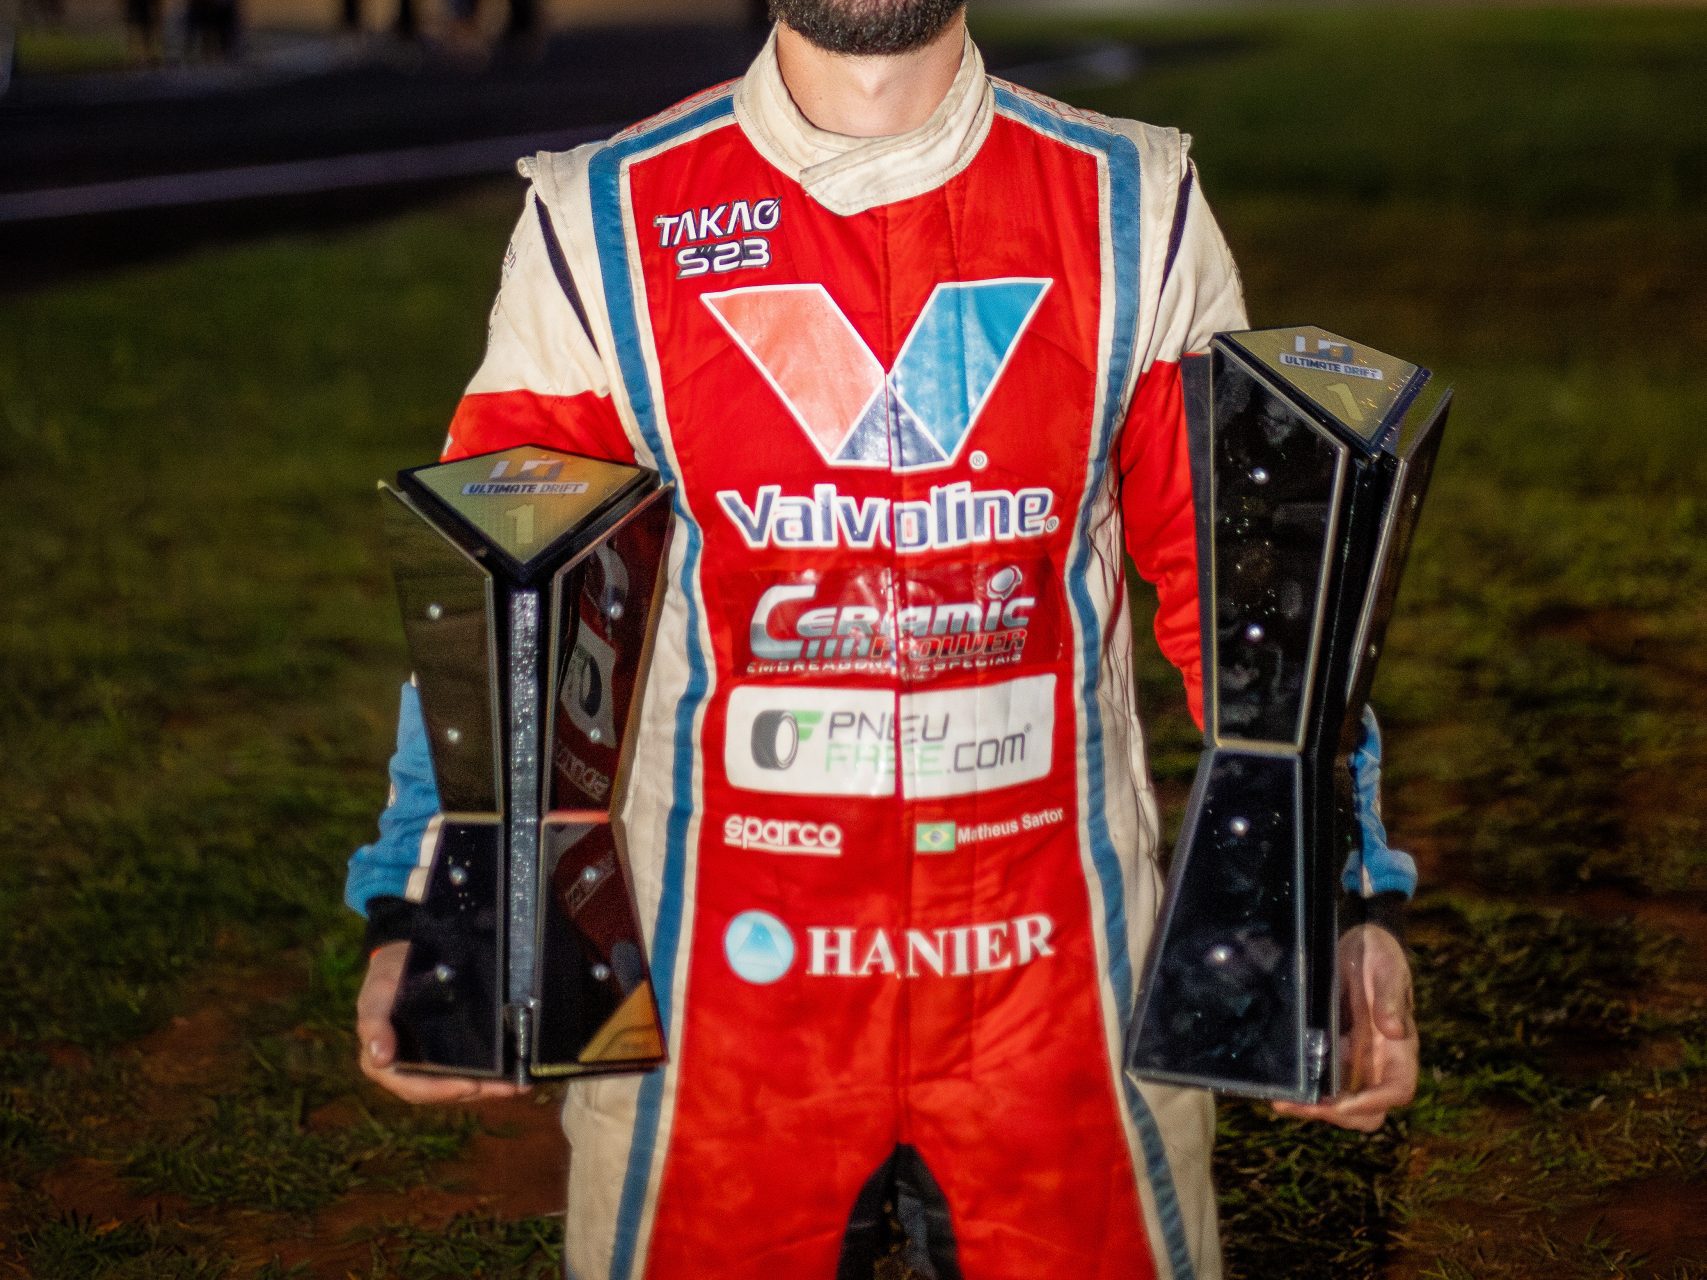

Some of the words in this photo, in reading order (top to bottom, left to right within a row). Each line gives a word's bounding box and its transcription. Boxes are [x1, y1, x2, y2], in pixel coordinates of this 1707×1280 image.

[655, 197, 782, 247] TAKAO
[676, 238, 771, 277] S23
[1284, 355, 1341, 372] ULTIMATE
[1344, 366, 1378, 379] DRIFT
[1326, 382, 1364, 421] 1
[468, 483, 538, 494] ULTIMATE
[540, 483, 584, 494] DRIFT
[505, 504, 535, 545] 1
[716, 481, 1055, 553] Valvoline
[828, 711, 950, 744] PNEU
[723, 814, 842, 854] sparco
[1021, 808, 1064, 830] Sartor
[806, 913, 1055, 978] HANIER
